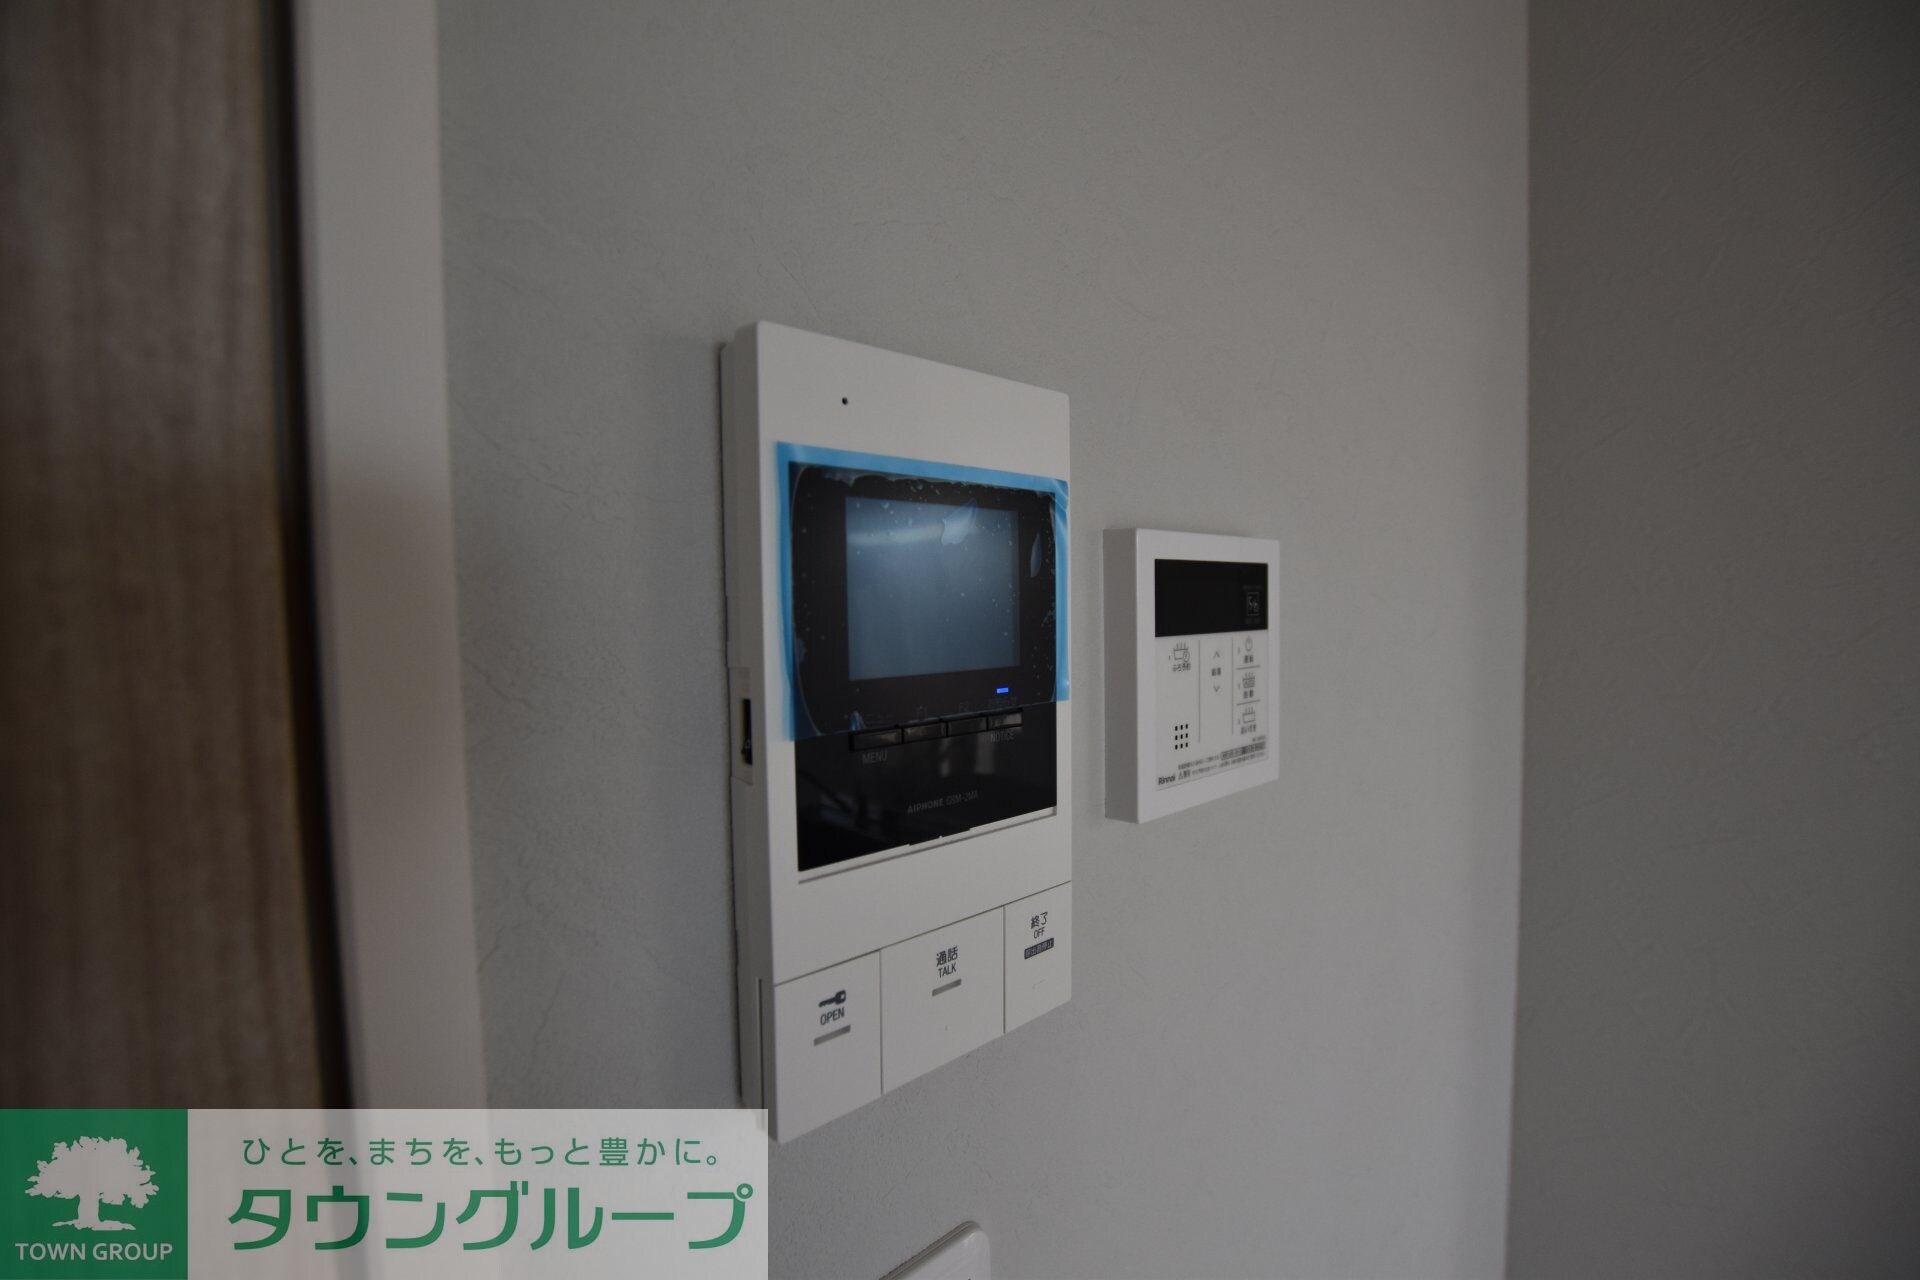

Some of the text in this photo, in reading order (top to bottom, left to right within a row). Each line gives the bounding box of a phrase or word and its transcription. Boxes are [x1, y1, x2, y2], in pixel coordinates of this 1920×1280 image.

[990, 729, 1016, 743] NOTICE
[862, 749, 887, 765] MENU
[1158, 773, 1176, 785] Rinnai
[907, 797, 944, 814] AIPHONE
[1031, 911, 1048, 929] 終了
[1033, 926, 1045, 939] OFF
[936, 946, 959, 967] 通話
[938, 963, 957, 979] TALK
[820, 1007, 845, 1026] OPEN
